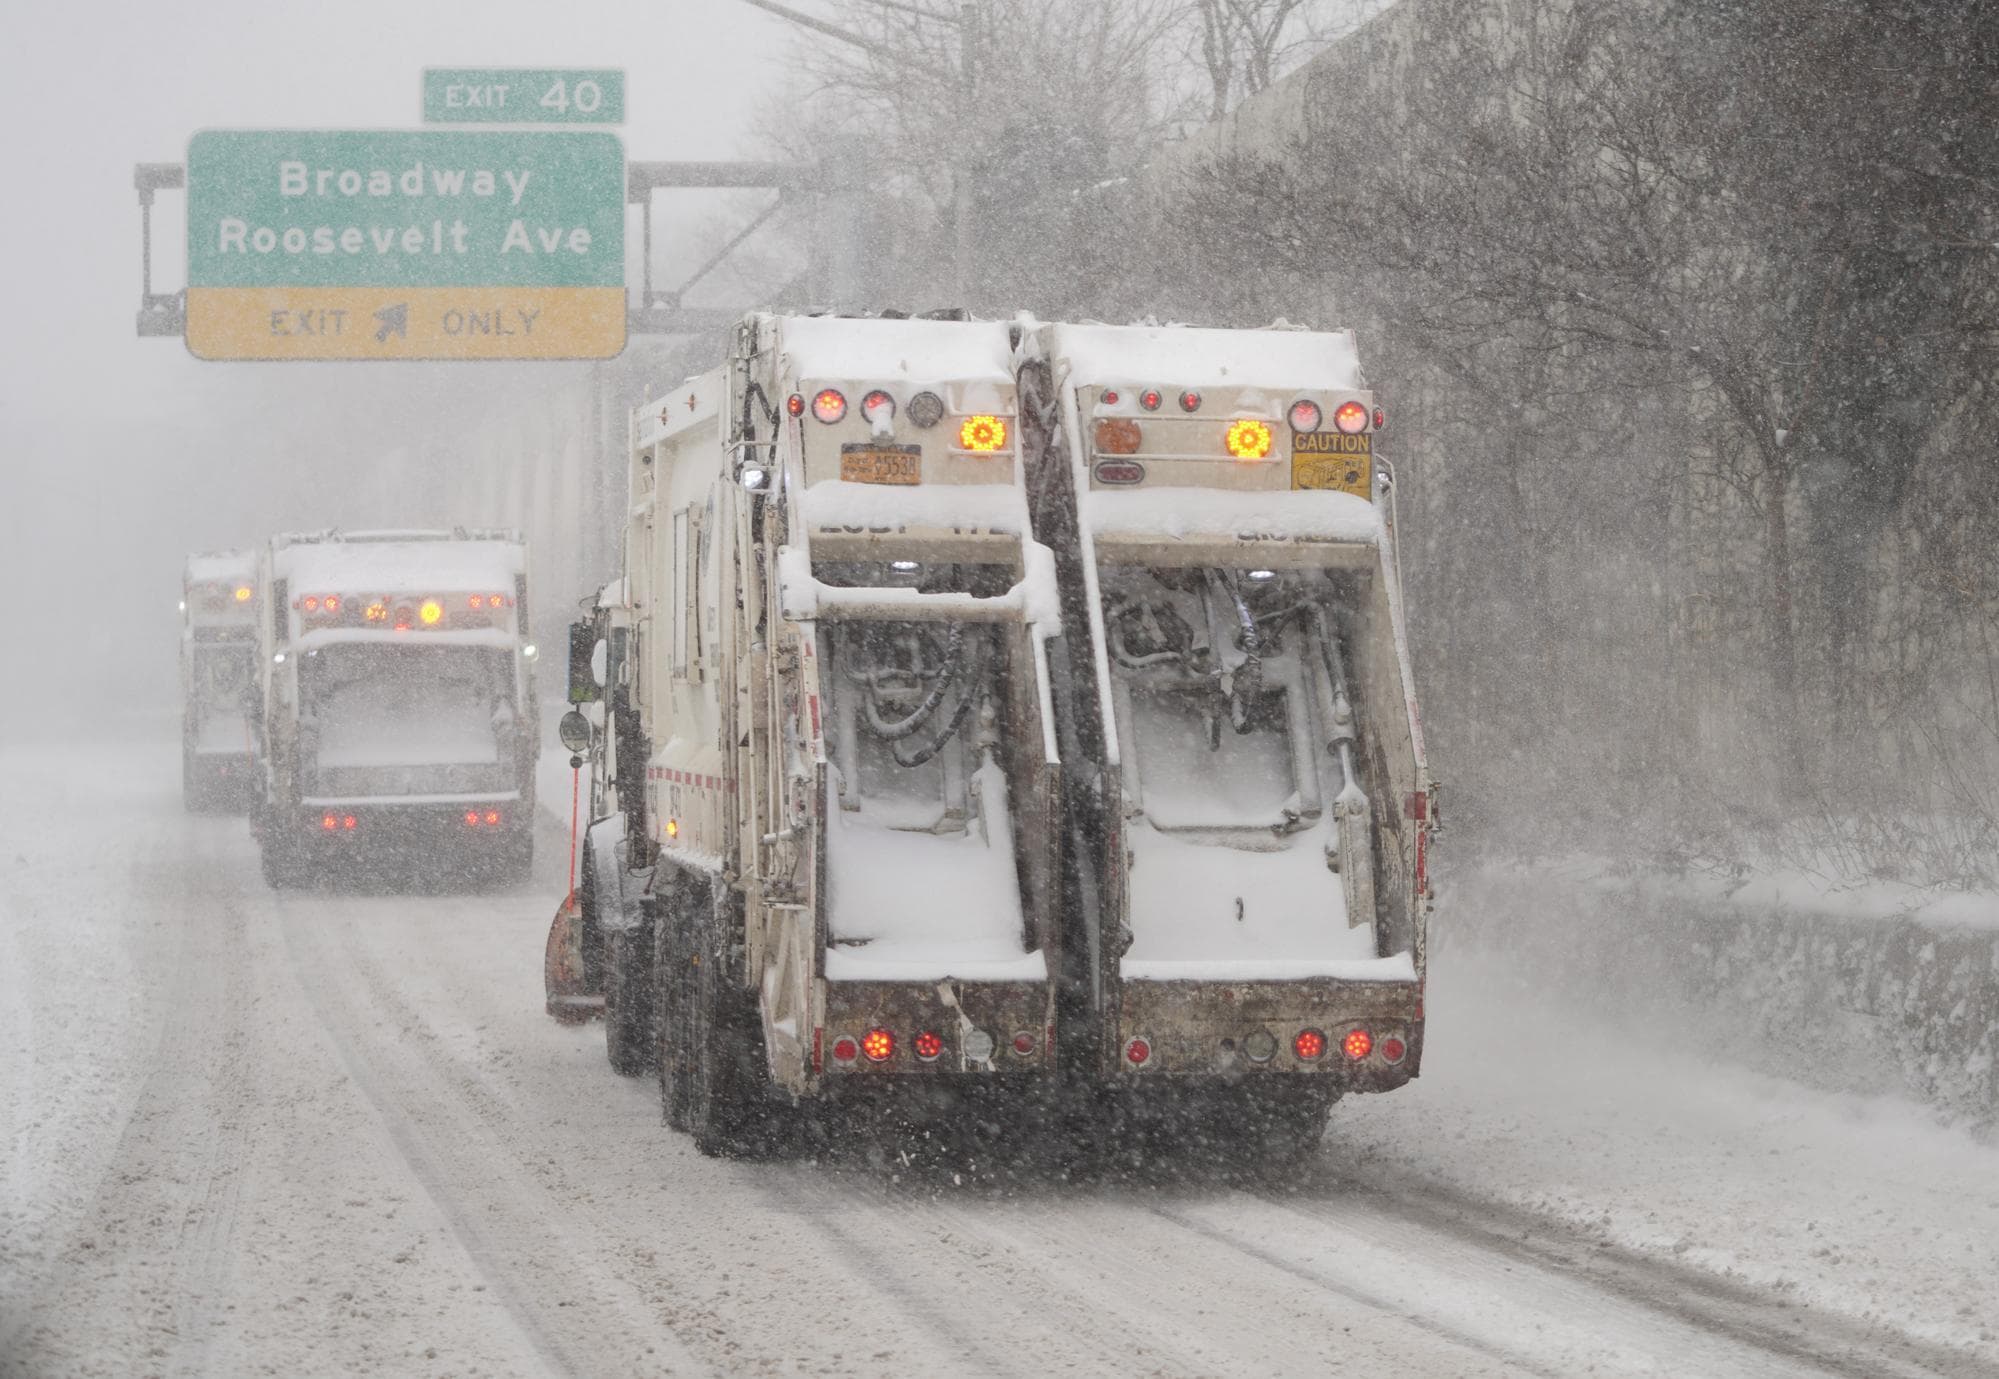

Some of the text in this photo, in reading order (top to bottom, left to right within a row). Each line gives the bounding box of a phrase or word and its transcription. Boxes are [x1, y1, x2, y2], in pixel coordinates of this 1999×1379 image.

[446, 79, 602, 113] EXIT 40
[279, 160, 532, 206] Broadway
[219, 216, 593, 254] Roosevelt Ave
[270, 308, 541, 337] EXIT ONLY
[1295, 432, 1370, 452] CAUTION
